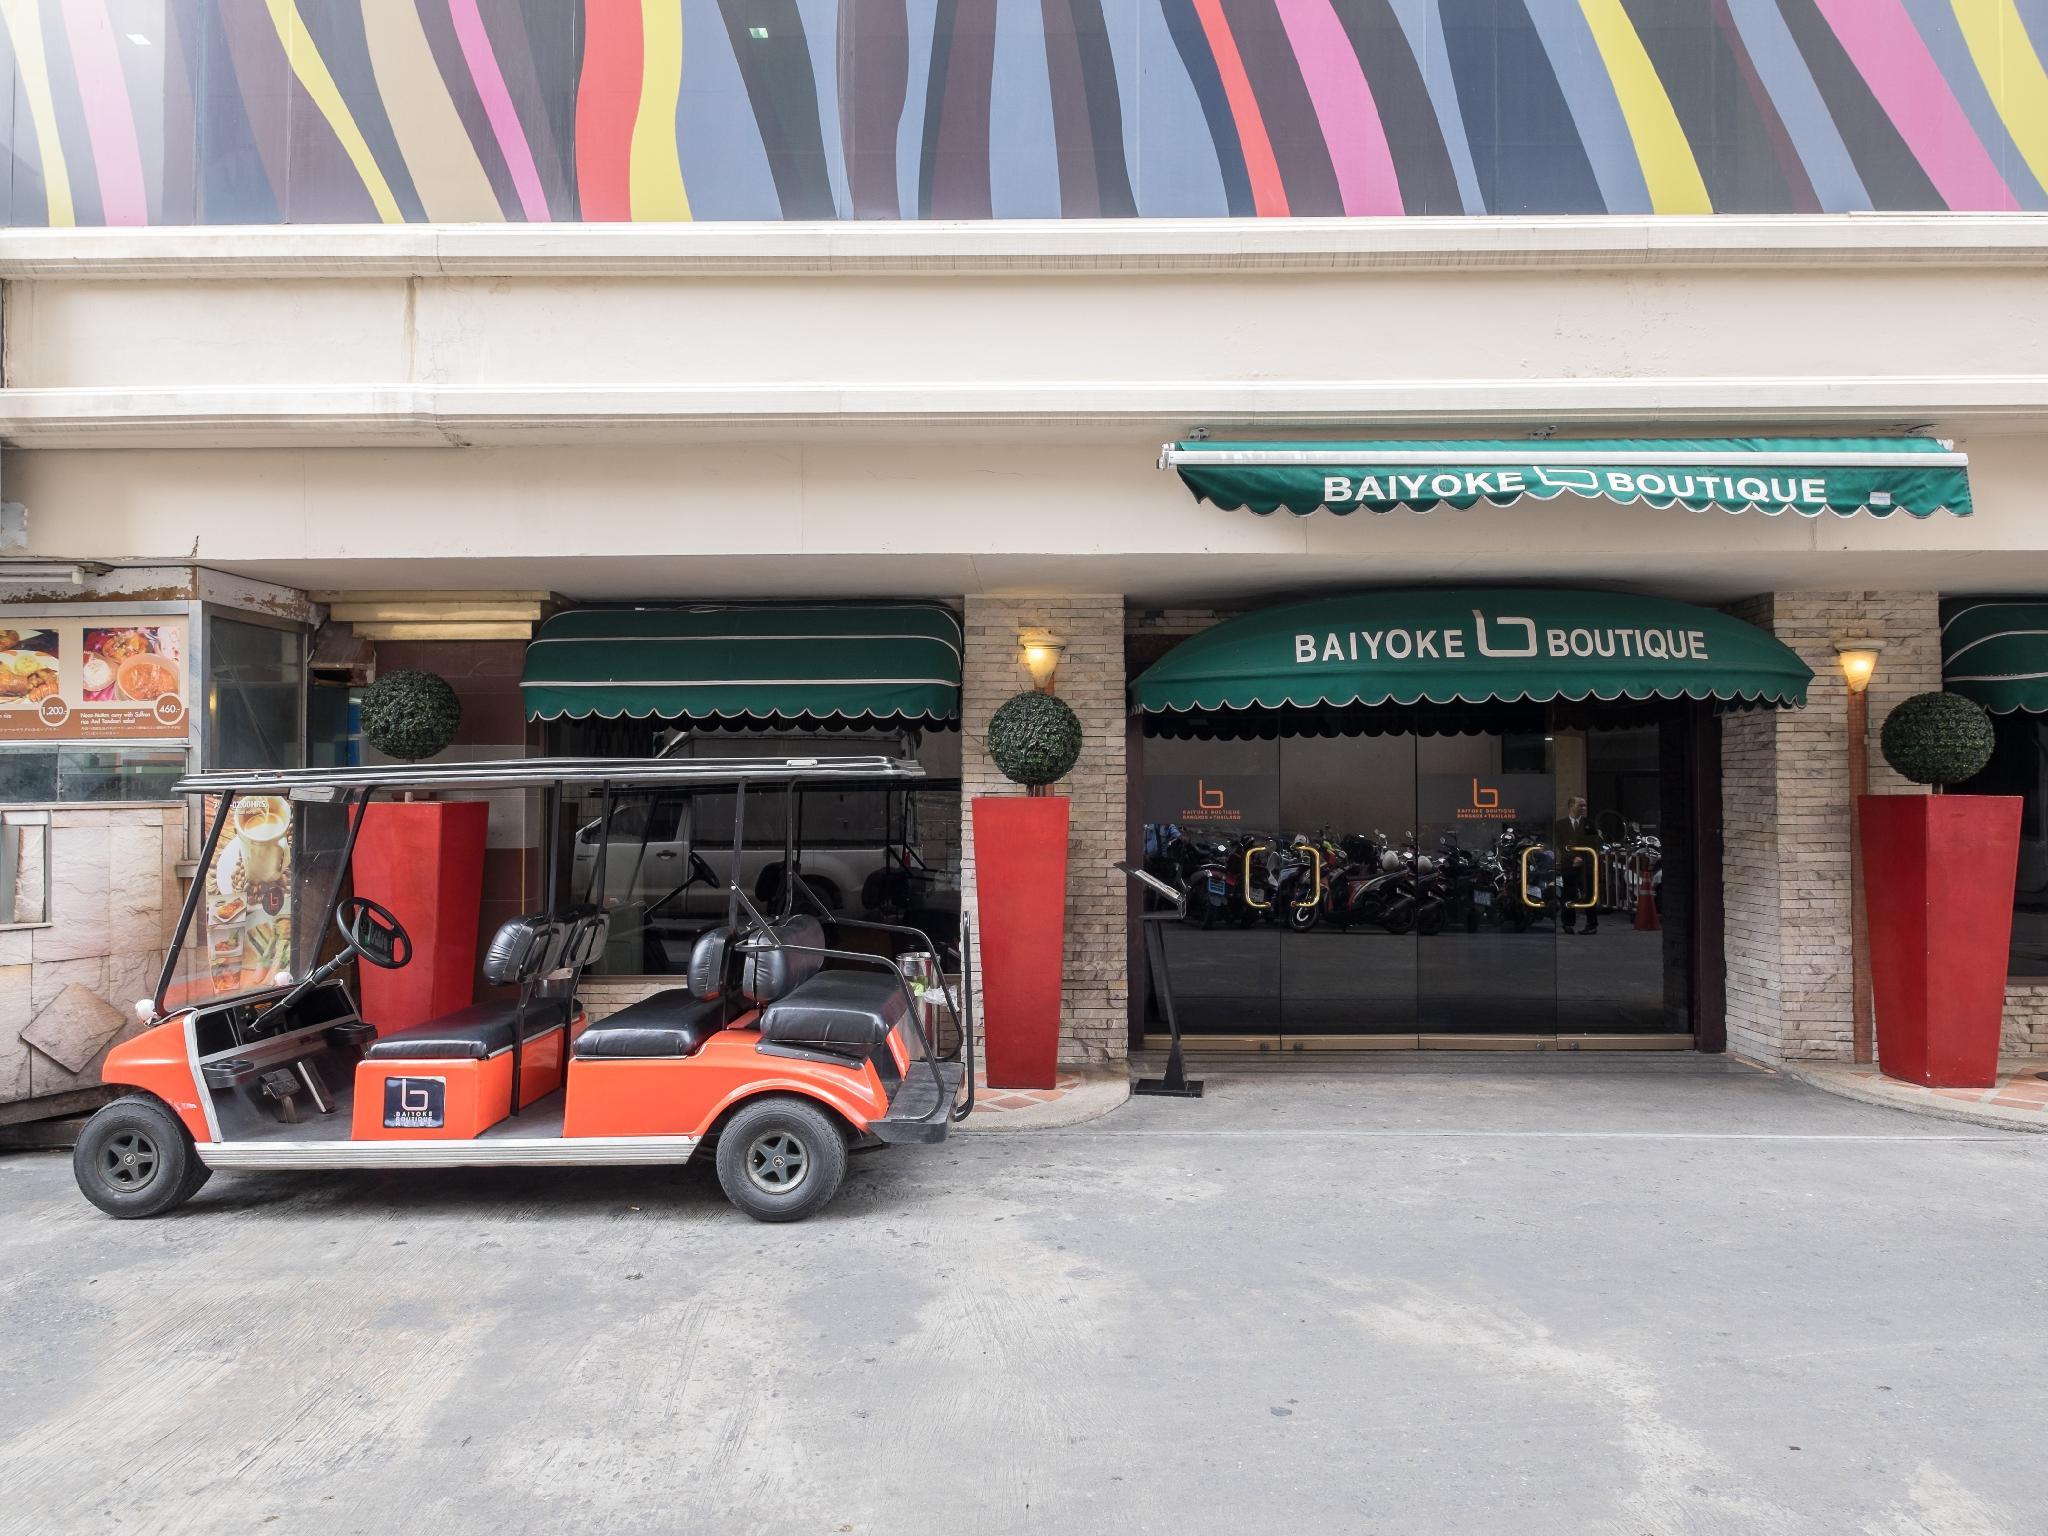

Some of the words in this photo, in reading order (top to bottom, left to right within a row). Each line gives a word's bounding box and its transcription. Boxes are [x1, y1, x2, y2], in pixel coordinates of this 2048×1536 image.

[1324, 472, 1526, 502] BAIYOKE
[1606, 472, 1827, 503] BOUTIQUE
[1295, 628, 1465, 663] BAIYOKE
[1546, 628, 1709, 660] BOUTIQUE
